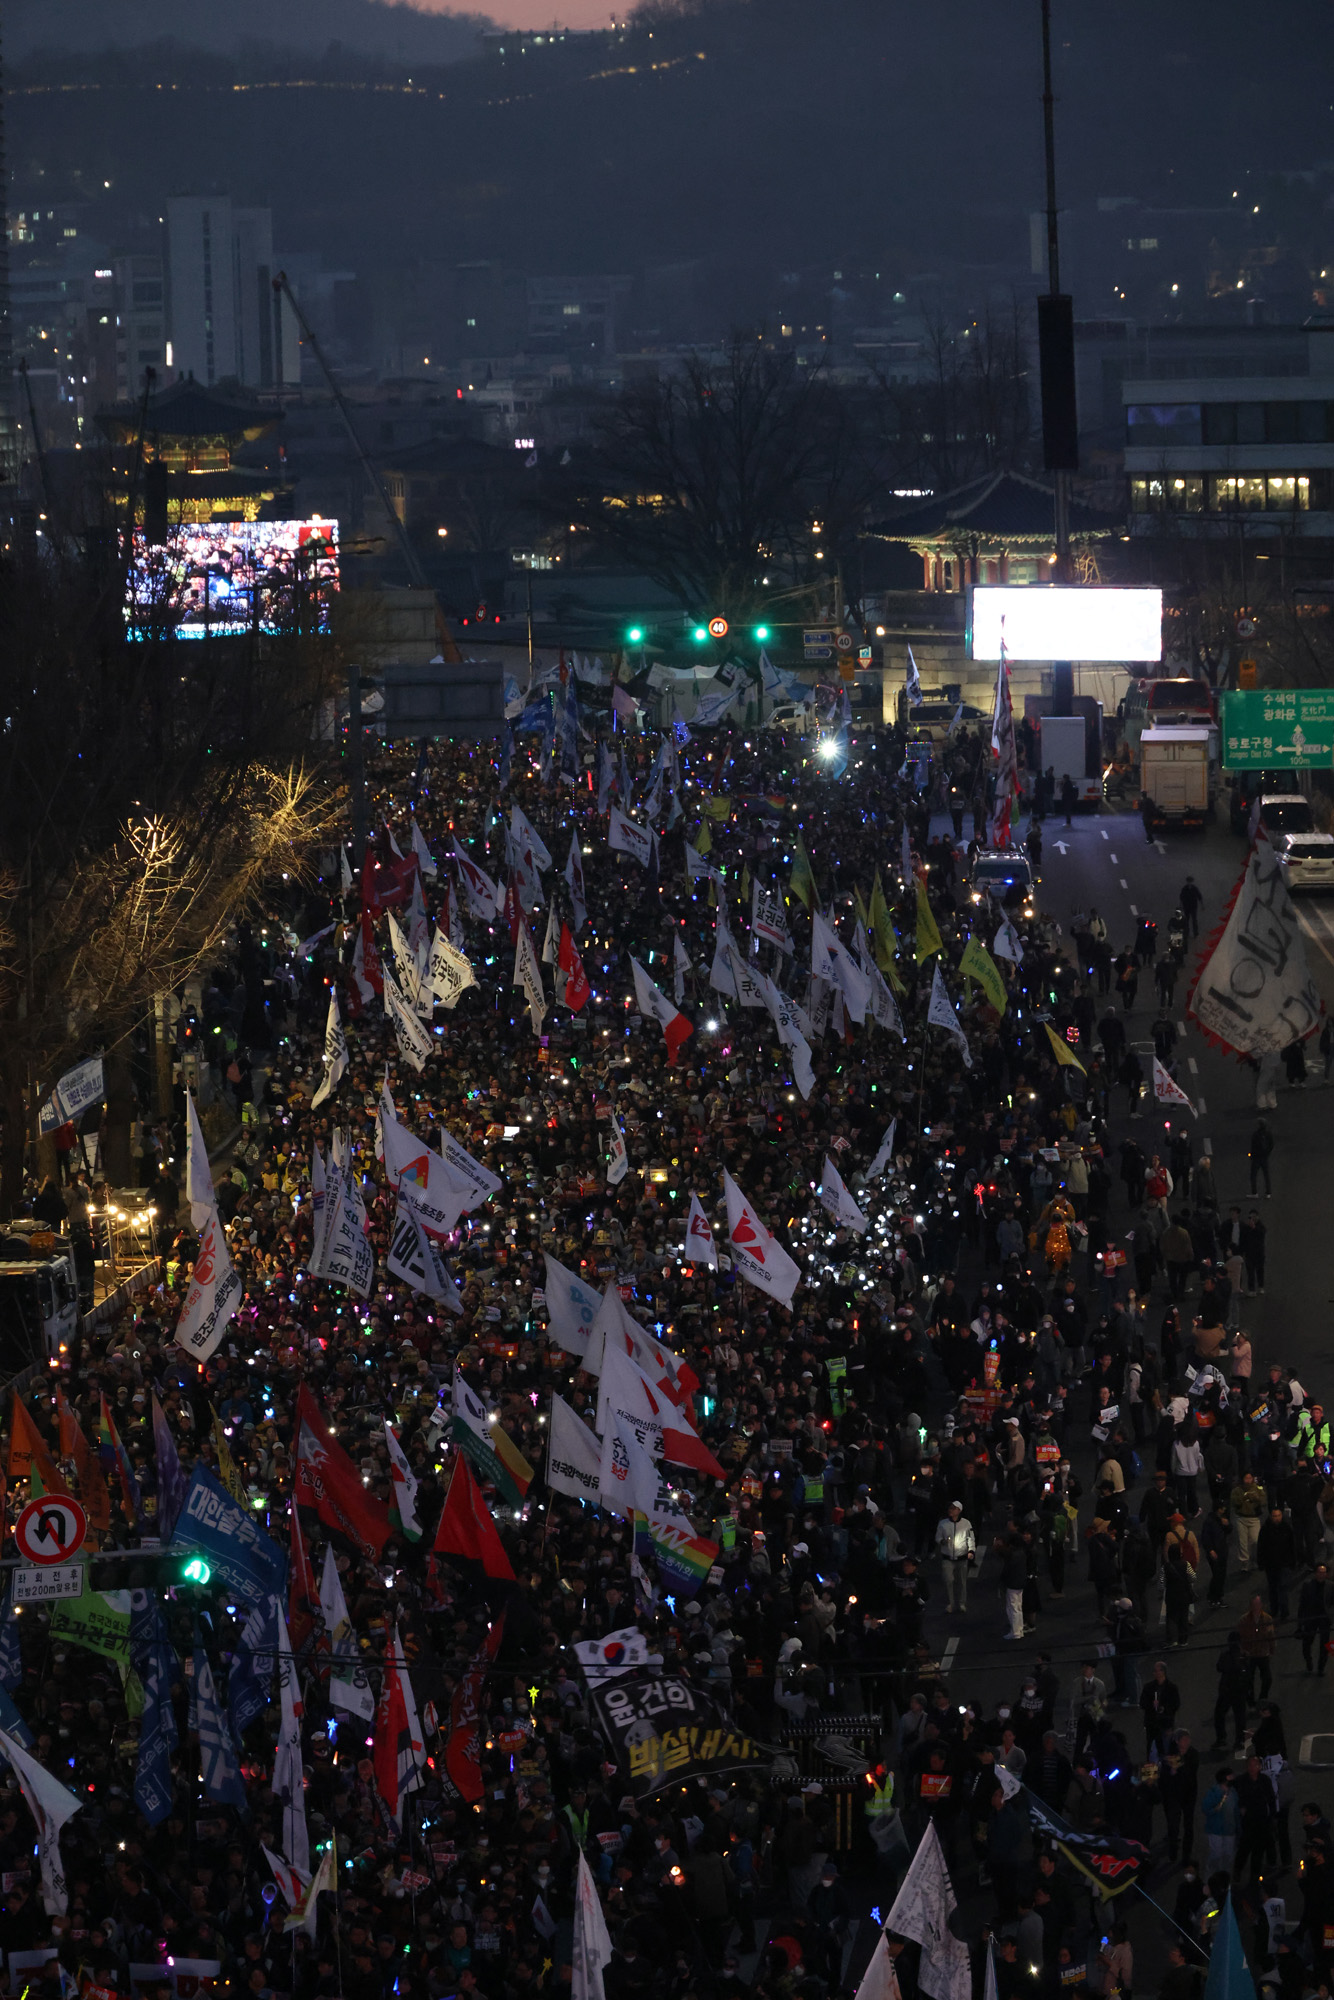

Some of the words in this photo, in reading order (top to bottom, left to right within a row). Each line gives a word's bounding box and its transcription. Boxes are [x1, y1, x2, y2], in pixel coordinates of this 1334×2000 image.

[712, 622, 724, 633] 40
[839, 636, 850, 647] 40
[1263, 694, 1296, 706] 수색역
[1263, 708, 1297, 721] 광화문
[1228, 737, 1273, 750] 종로구청
[1290, 756, 1311, 765] 100m
